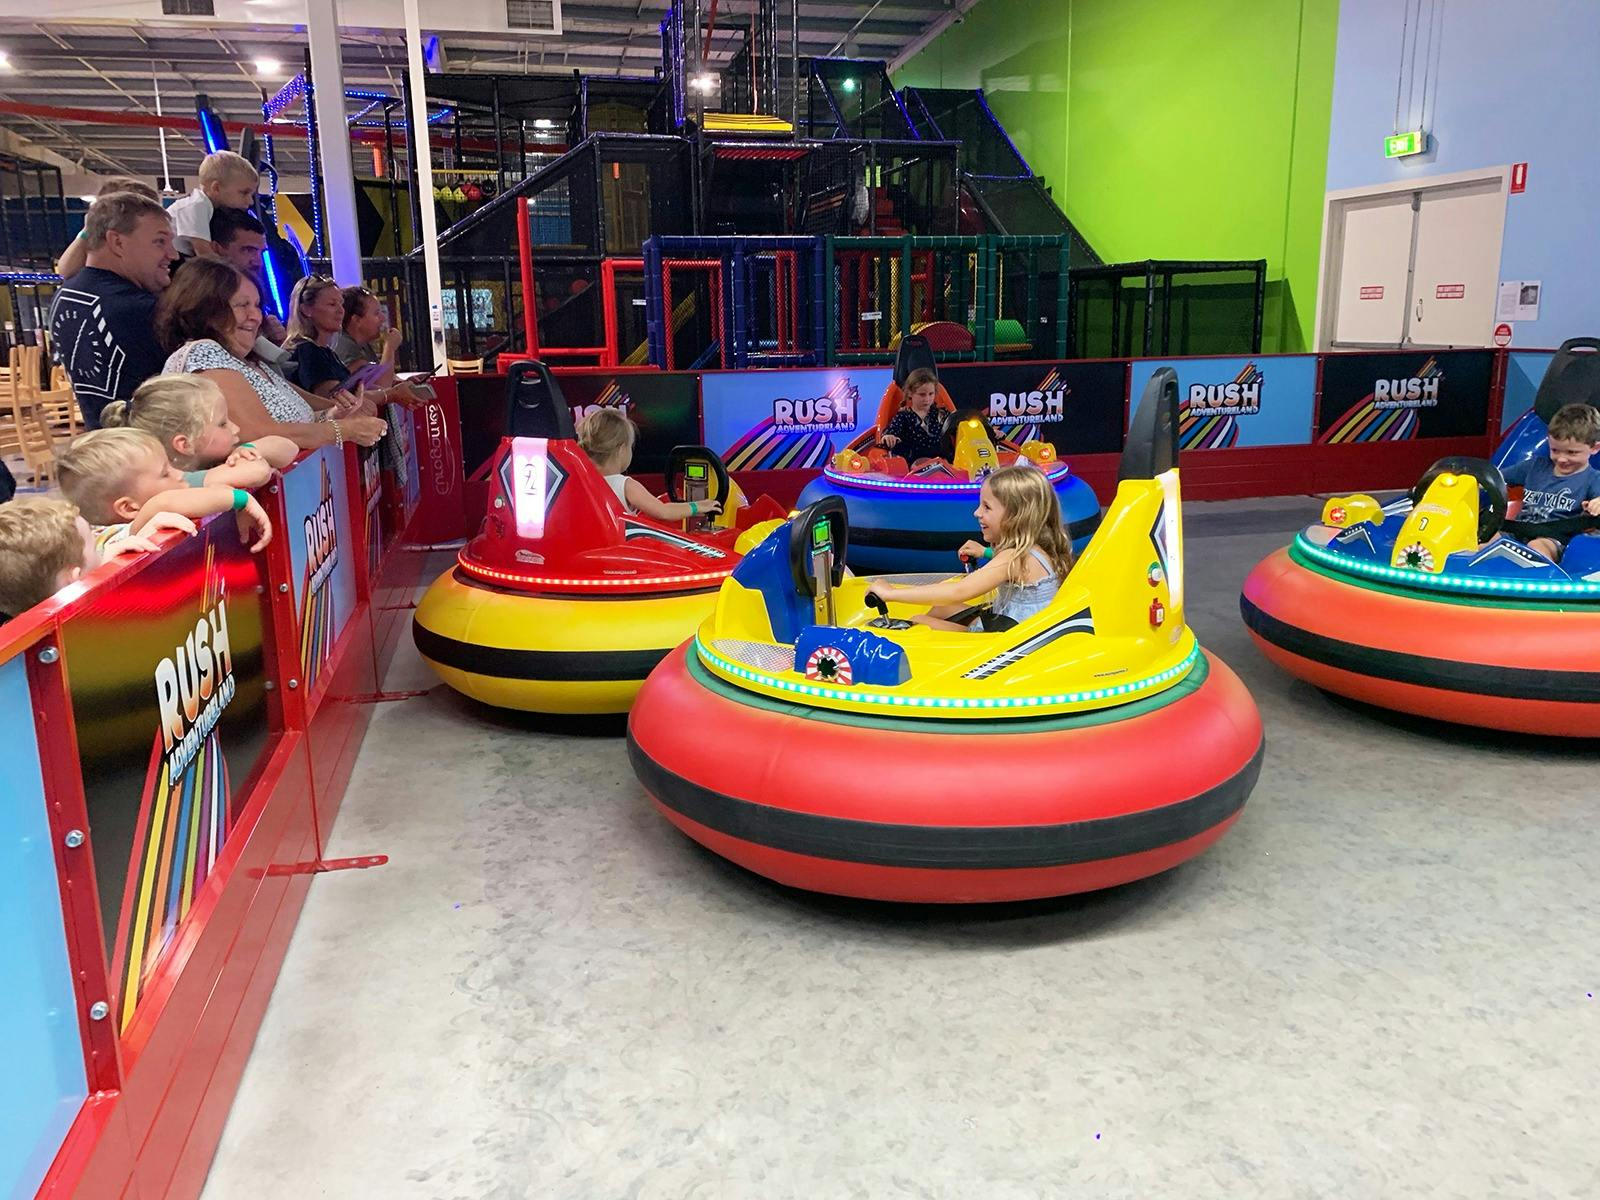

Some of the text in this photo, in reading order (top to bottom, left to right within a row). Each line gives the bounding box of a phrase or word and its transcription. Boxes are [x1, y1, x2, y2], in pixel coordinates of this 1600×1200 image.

[1190, 383, 1259, 408] RUSH
[1374, 377, 1439, 402] RUSH
[775, 398, 854, 425] RUSH
[990, 390, 1064, 417] RUSH
[1190, 405, 1259, 416] ADVENTURELAND
[776, 422, 855, 434] ADVENTURELAND
[991, 414, 1064, 425] ADVENTURELAND
[1418, 517, 1429, 531] 1
[304, 497, 337, 577] RUSH
[155, 600, 232, 754] RUSH
[170, 674, 235, 786] ADVENTURELAND
